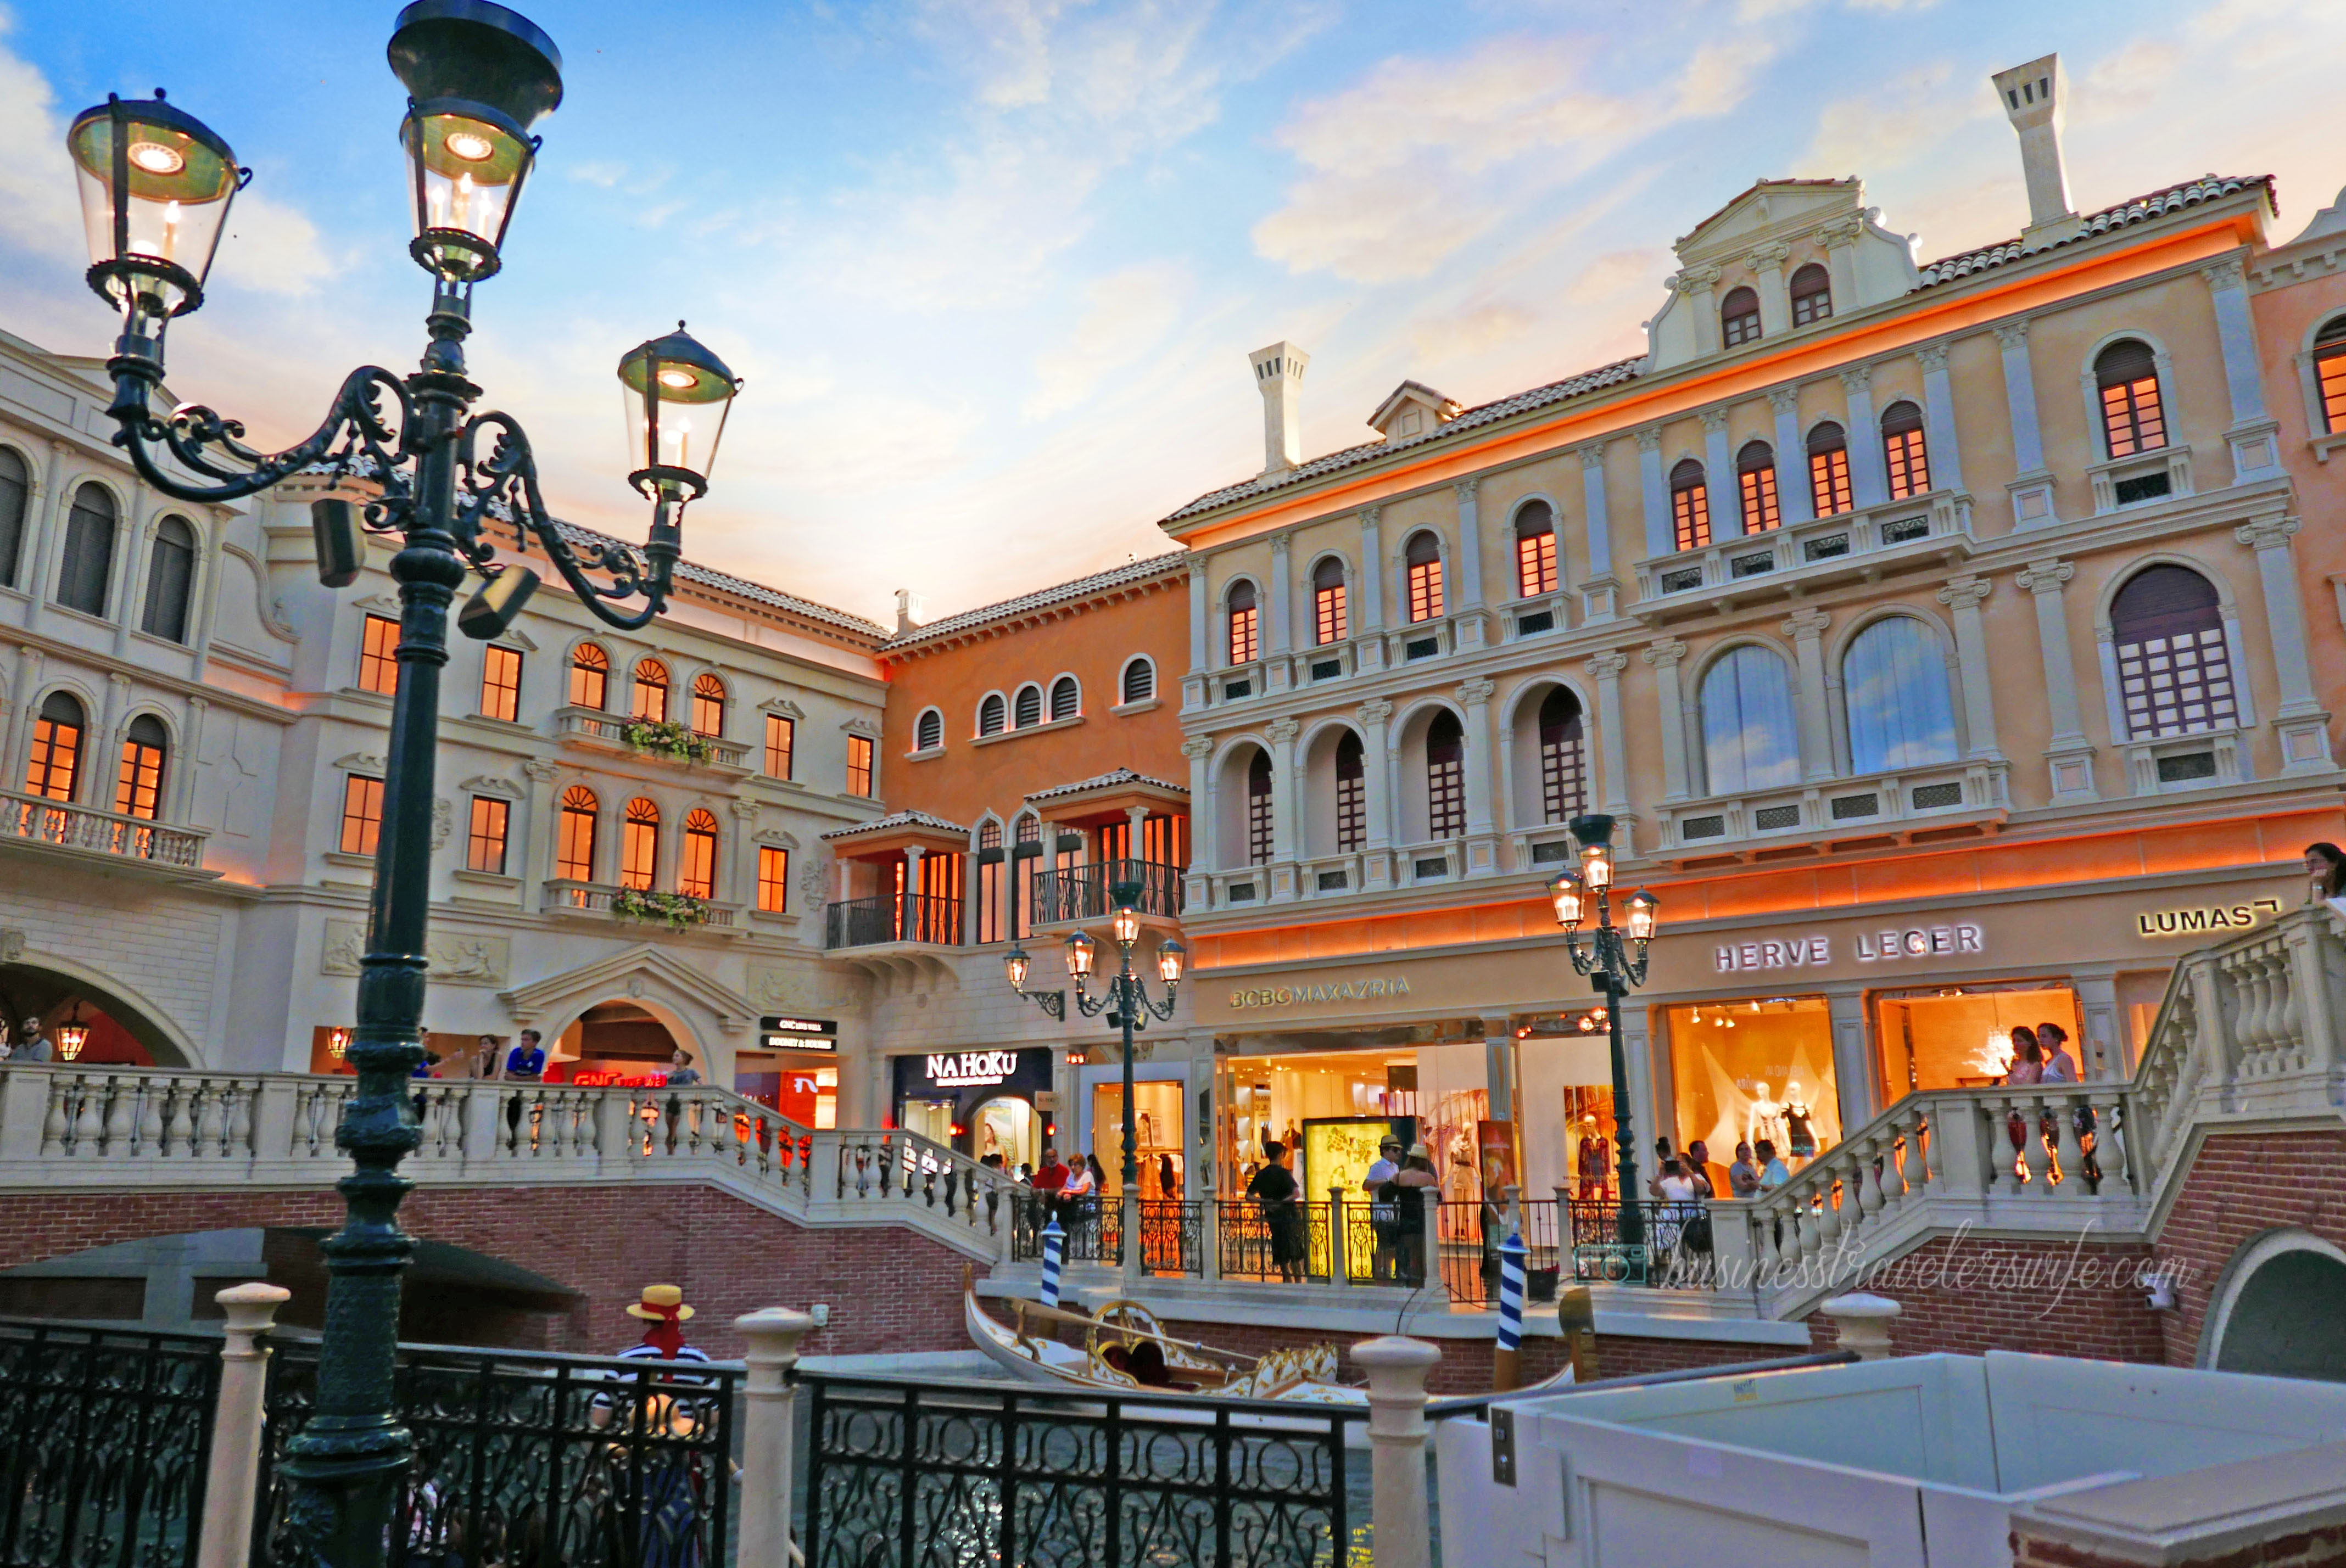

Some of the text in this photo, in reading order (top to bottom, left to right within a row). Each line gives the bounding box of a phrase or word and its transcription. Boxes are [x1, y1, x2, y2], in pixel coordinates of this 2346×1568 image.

[2140, 906, 2253, 934] LUMAS
[1715, 925, 1981, 971] HERVE LEGER
[1230, 977, 1410, 1009] BCBGMAXAZRIA
[926, 1051, 1018, 1078] NA HOKU
